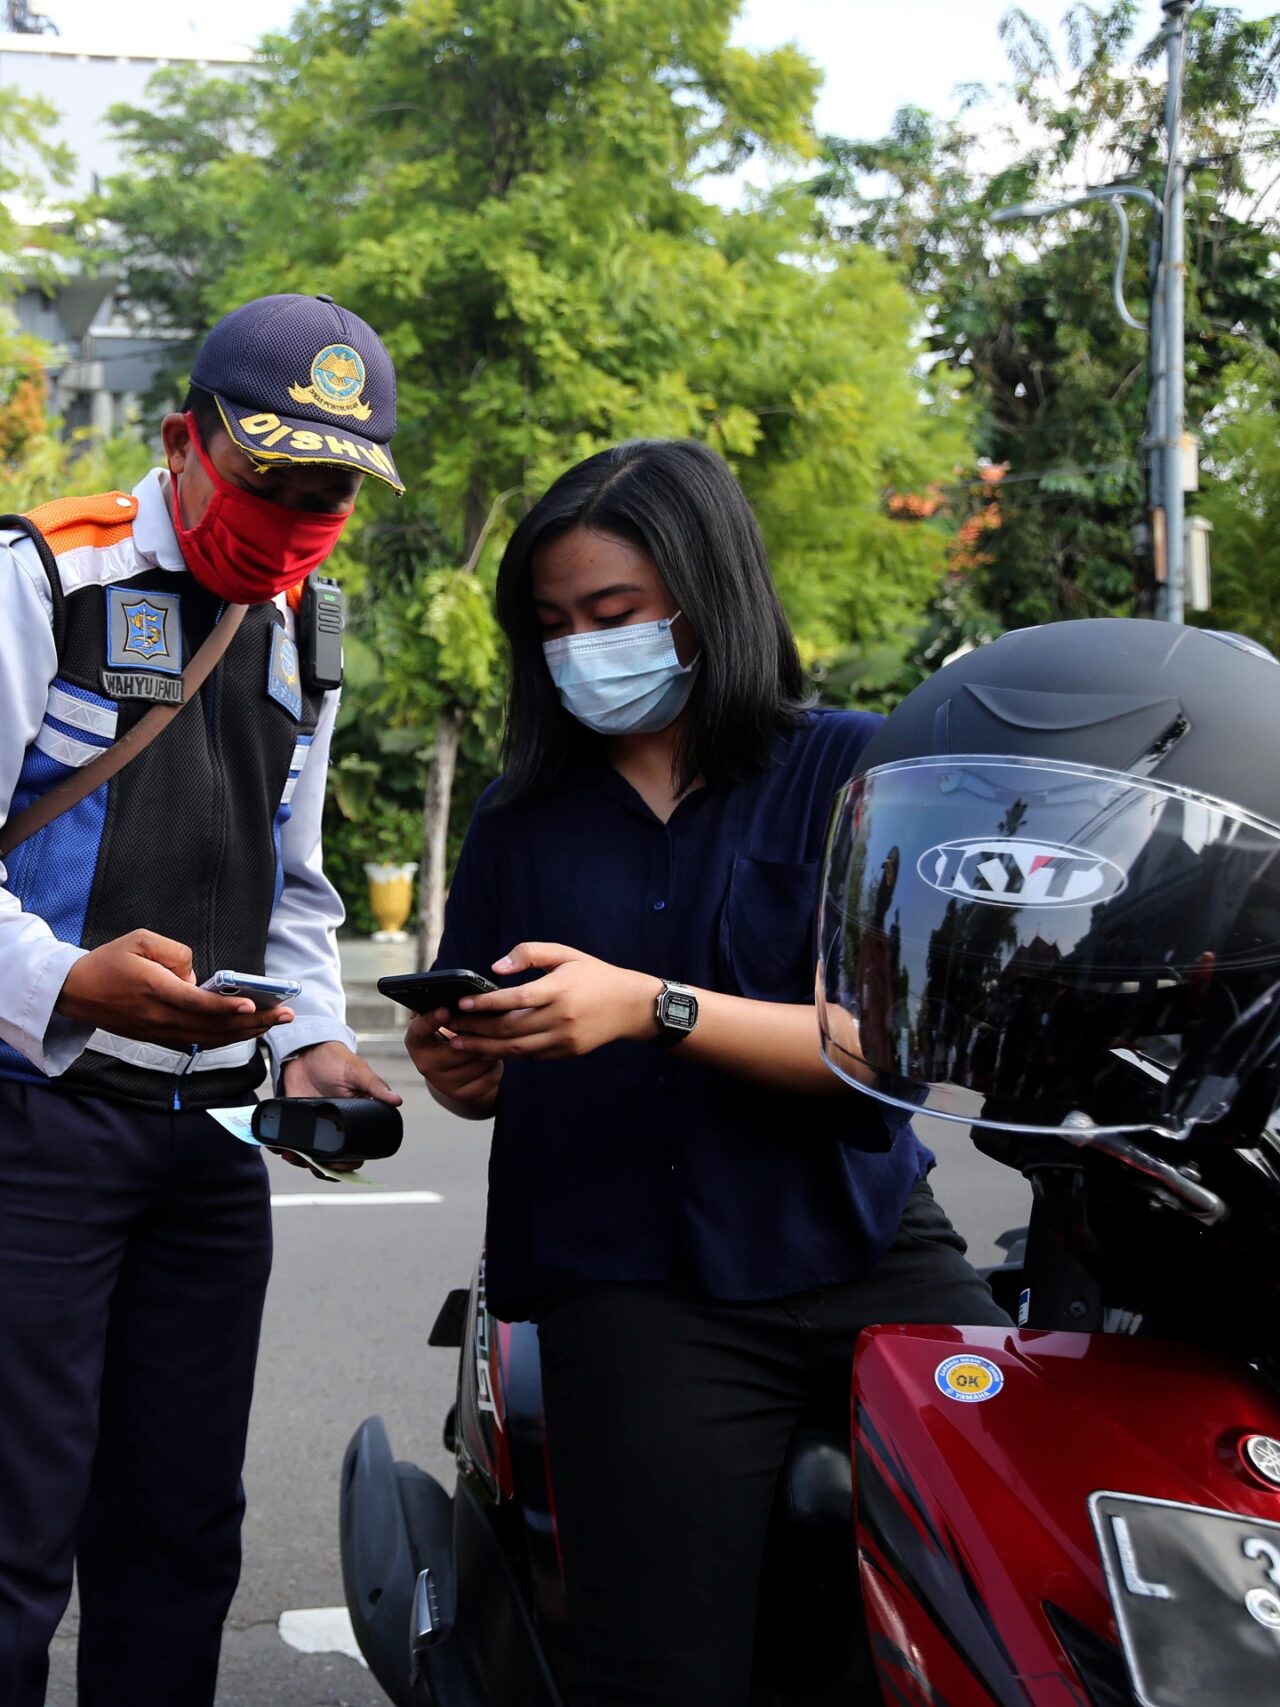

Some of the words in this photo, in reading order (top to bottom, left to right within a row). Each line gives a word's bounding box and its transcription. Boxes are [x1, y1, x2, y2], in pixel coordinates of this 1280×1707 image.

[105, 674, 153, 696] WAHYU
[936, 847, 1106, 899] KYT
[956, 1375, 980, 1388] OK
[955, 1391, 991, 1400] YAMAHA
[1111, 1516, 1173, 1598] L
